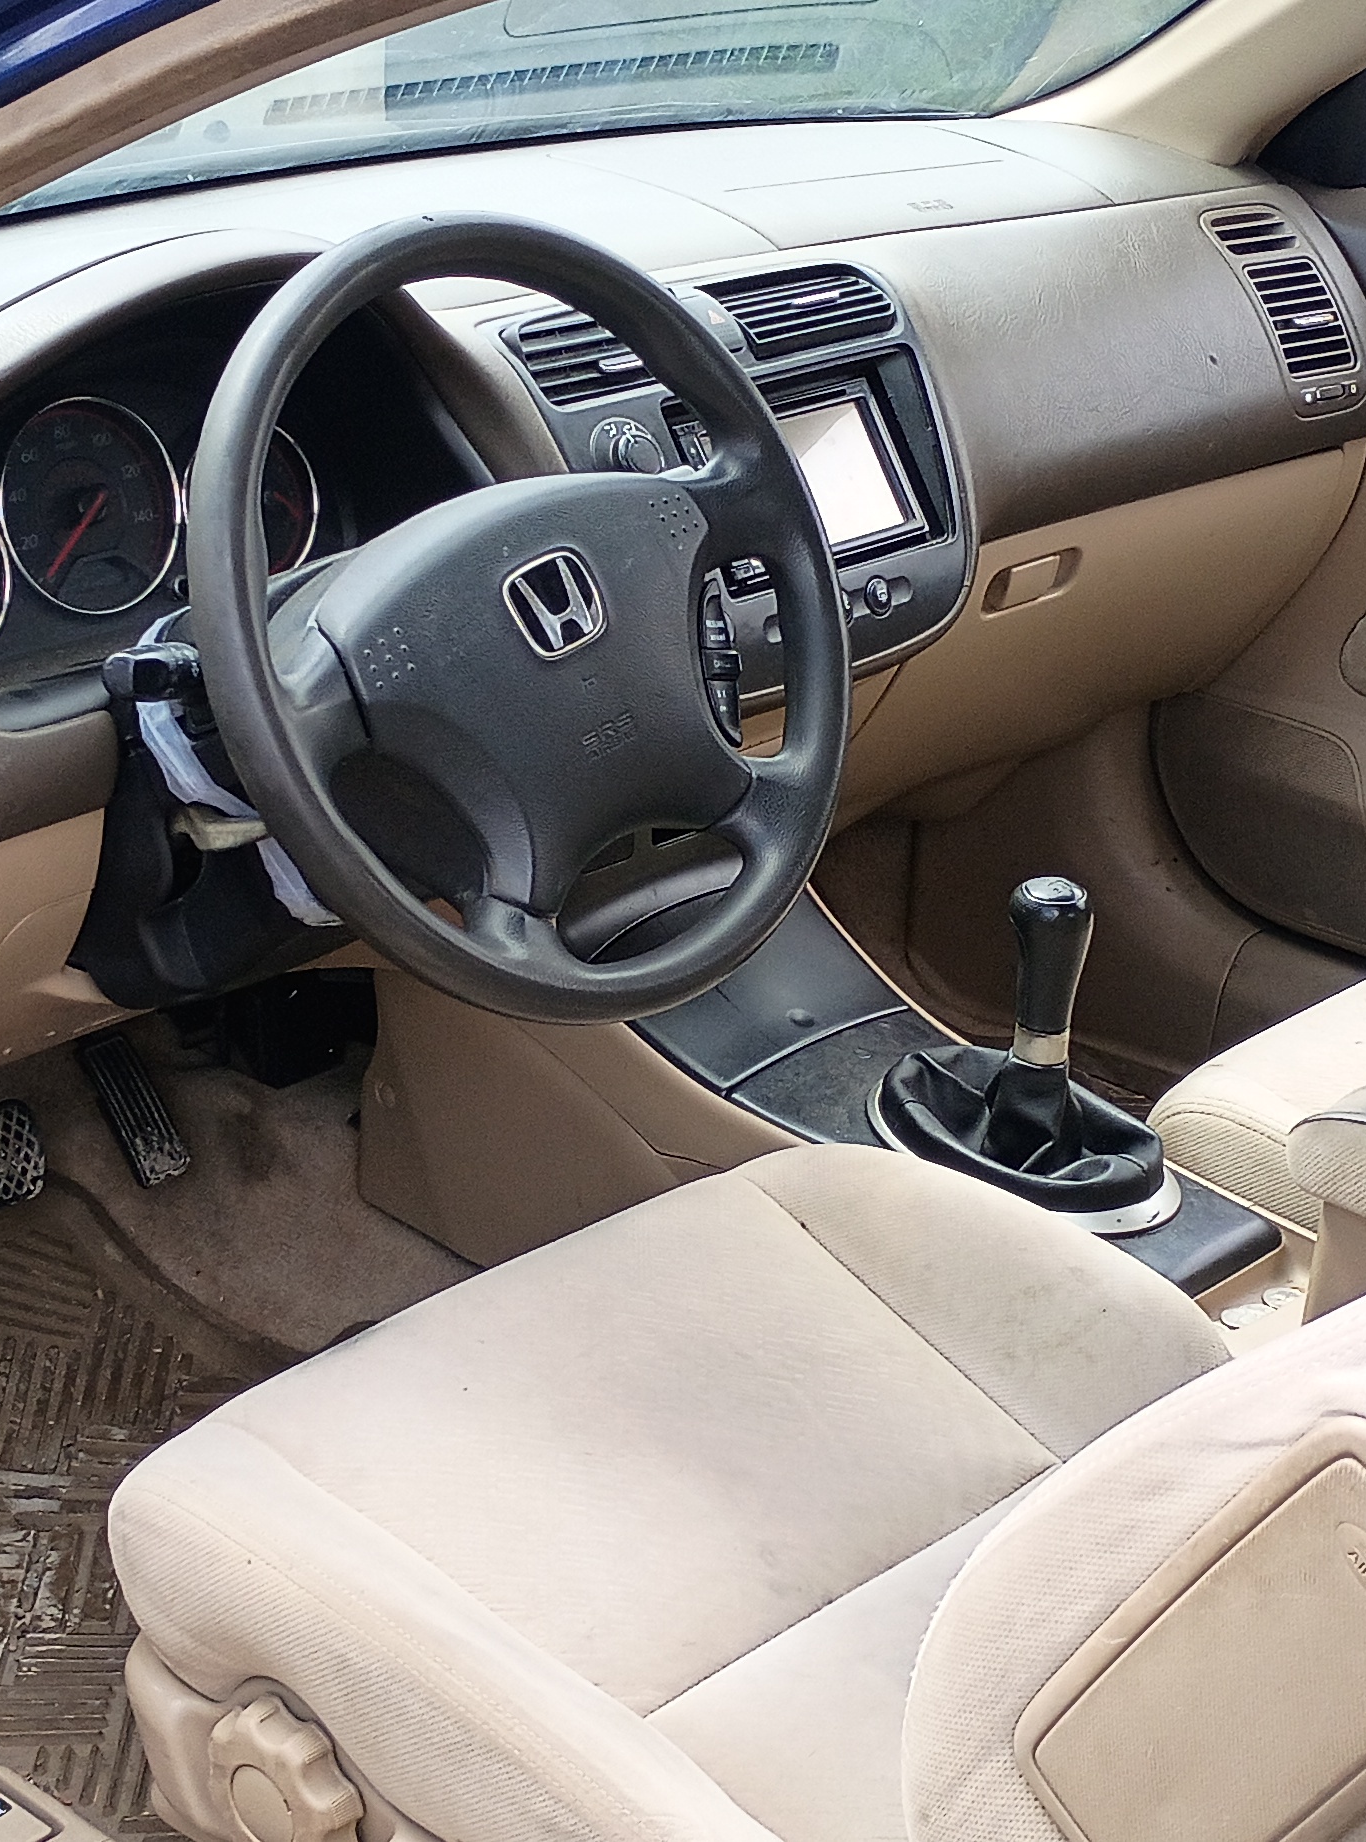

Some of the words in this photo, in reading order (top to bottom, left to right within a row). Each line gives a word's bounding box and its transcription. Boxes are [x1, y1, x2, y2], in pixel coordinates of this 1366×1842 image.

[54, 425, 70, 439] 80
[21, 449, 37, 463] 60
[121, 464, 140, 479] 120
[9, 488, 26, 504] 40
[133, 508, 153, 523] 140
[21, 534, 38, 550] 20
